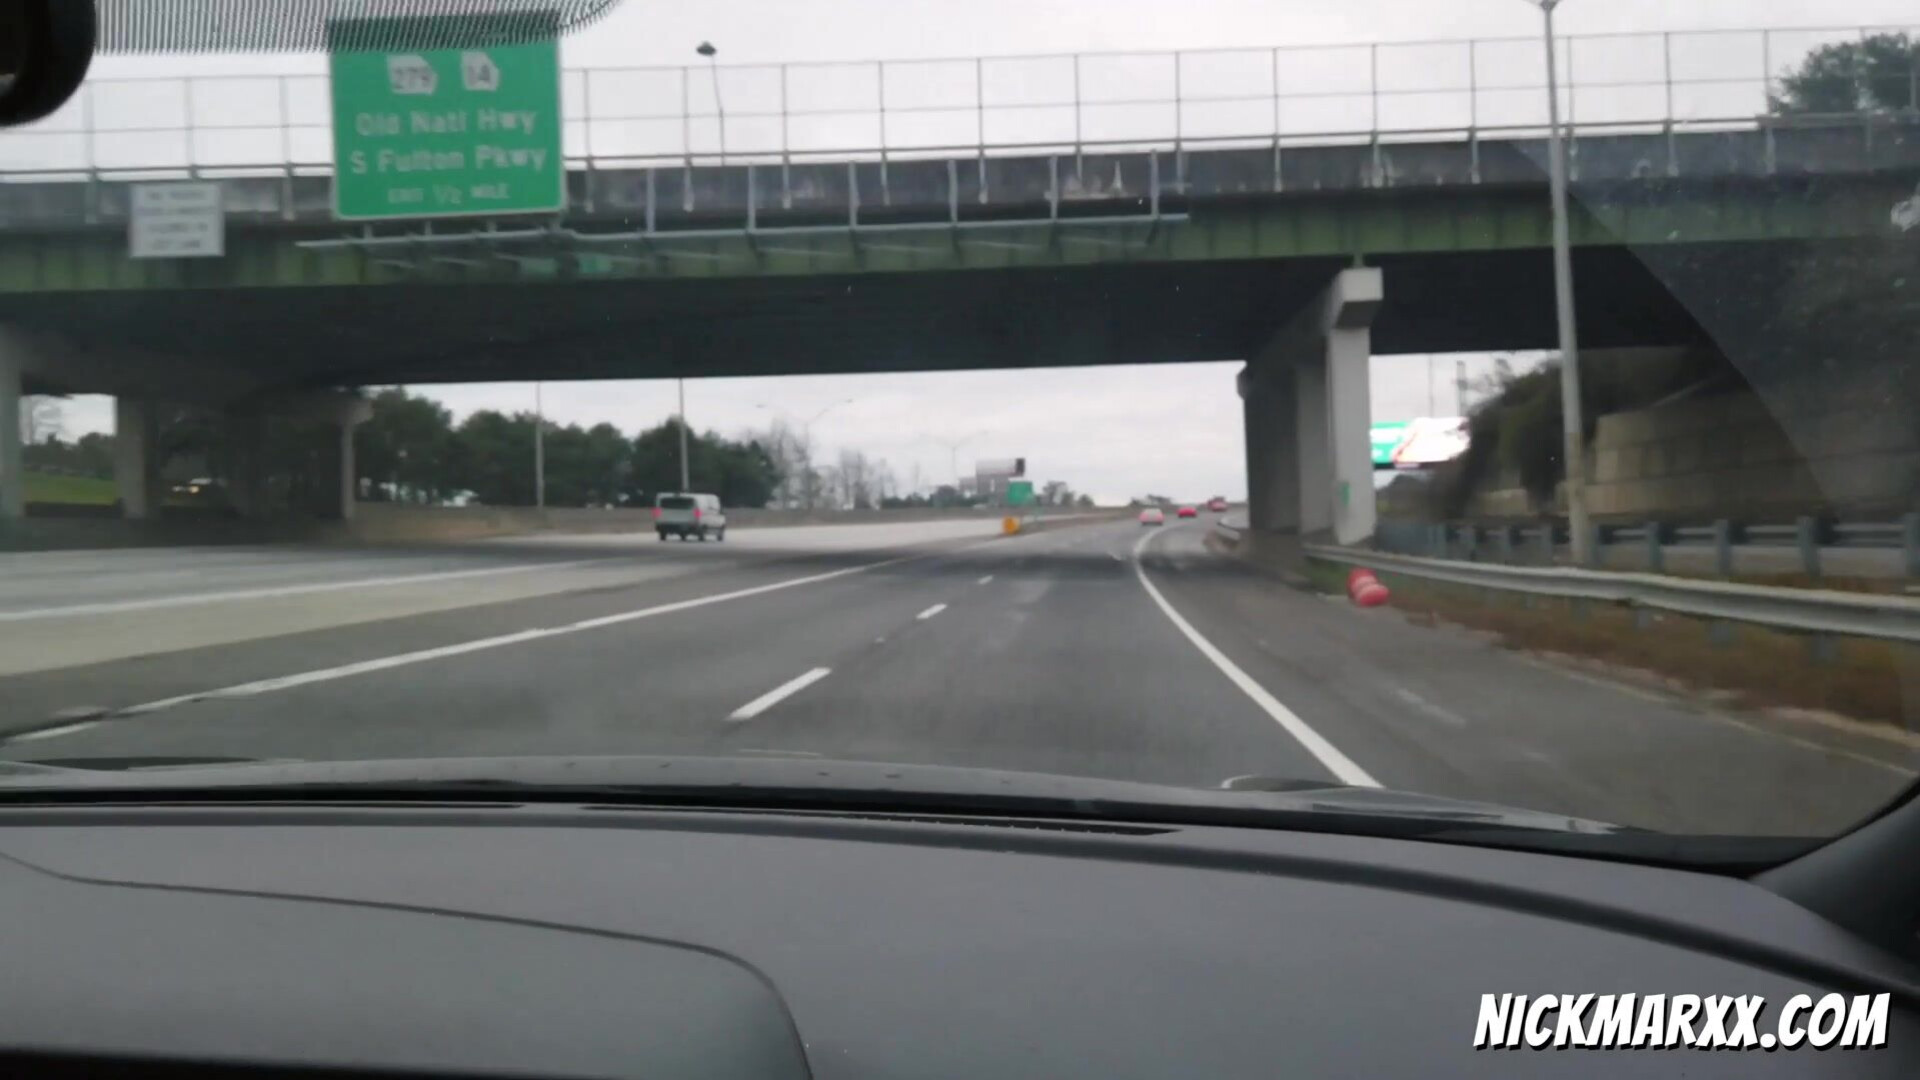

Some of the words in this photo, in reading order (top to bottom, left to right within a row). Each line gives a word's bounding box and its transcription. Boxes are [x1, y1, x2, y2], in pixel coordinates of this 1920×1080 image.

[391, 66, 432, 90] 279
[467, 63, 492, 84] 14
[356, 112, 399, 136] Old
[477, 108, 537, 135] Hwy
[351, 151, 367, 174] S
[377, 148, 465, 173] Fulton
[475, 144, 547, 173] Pkwy
